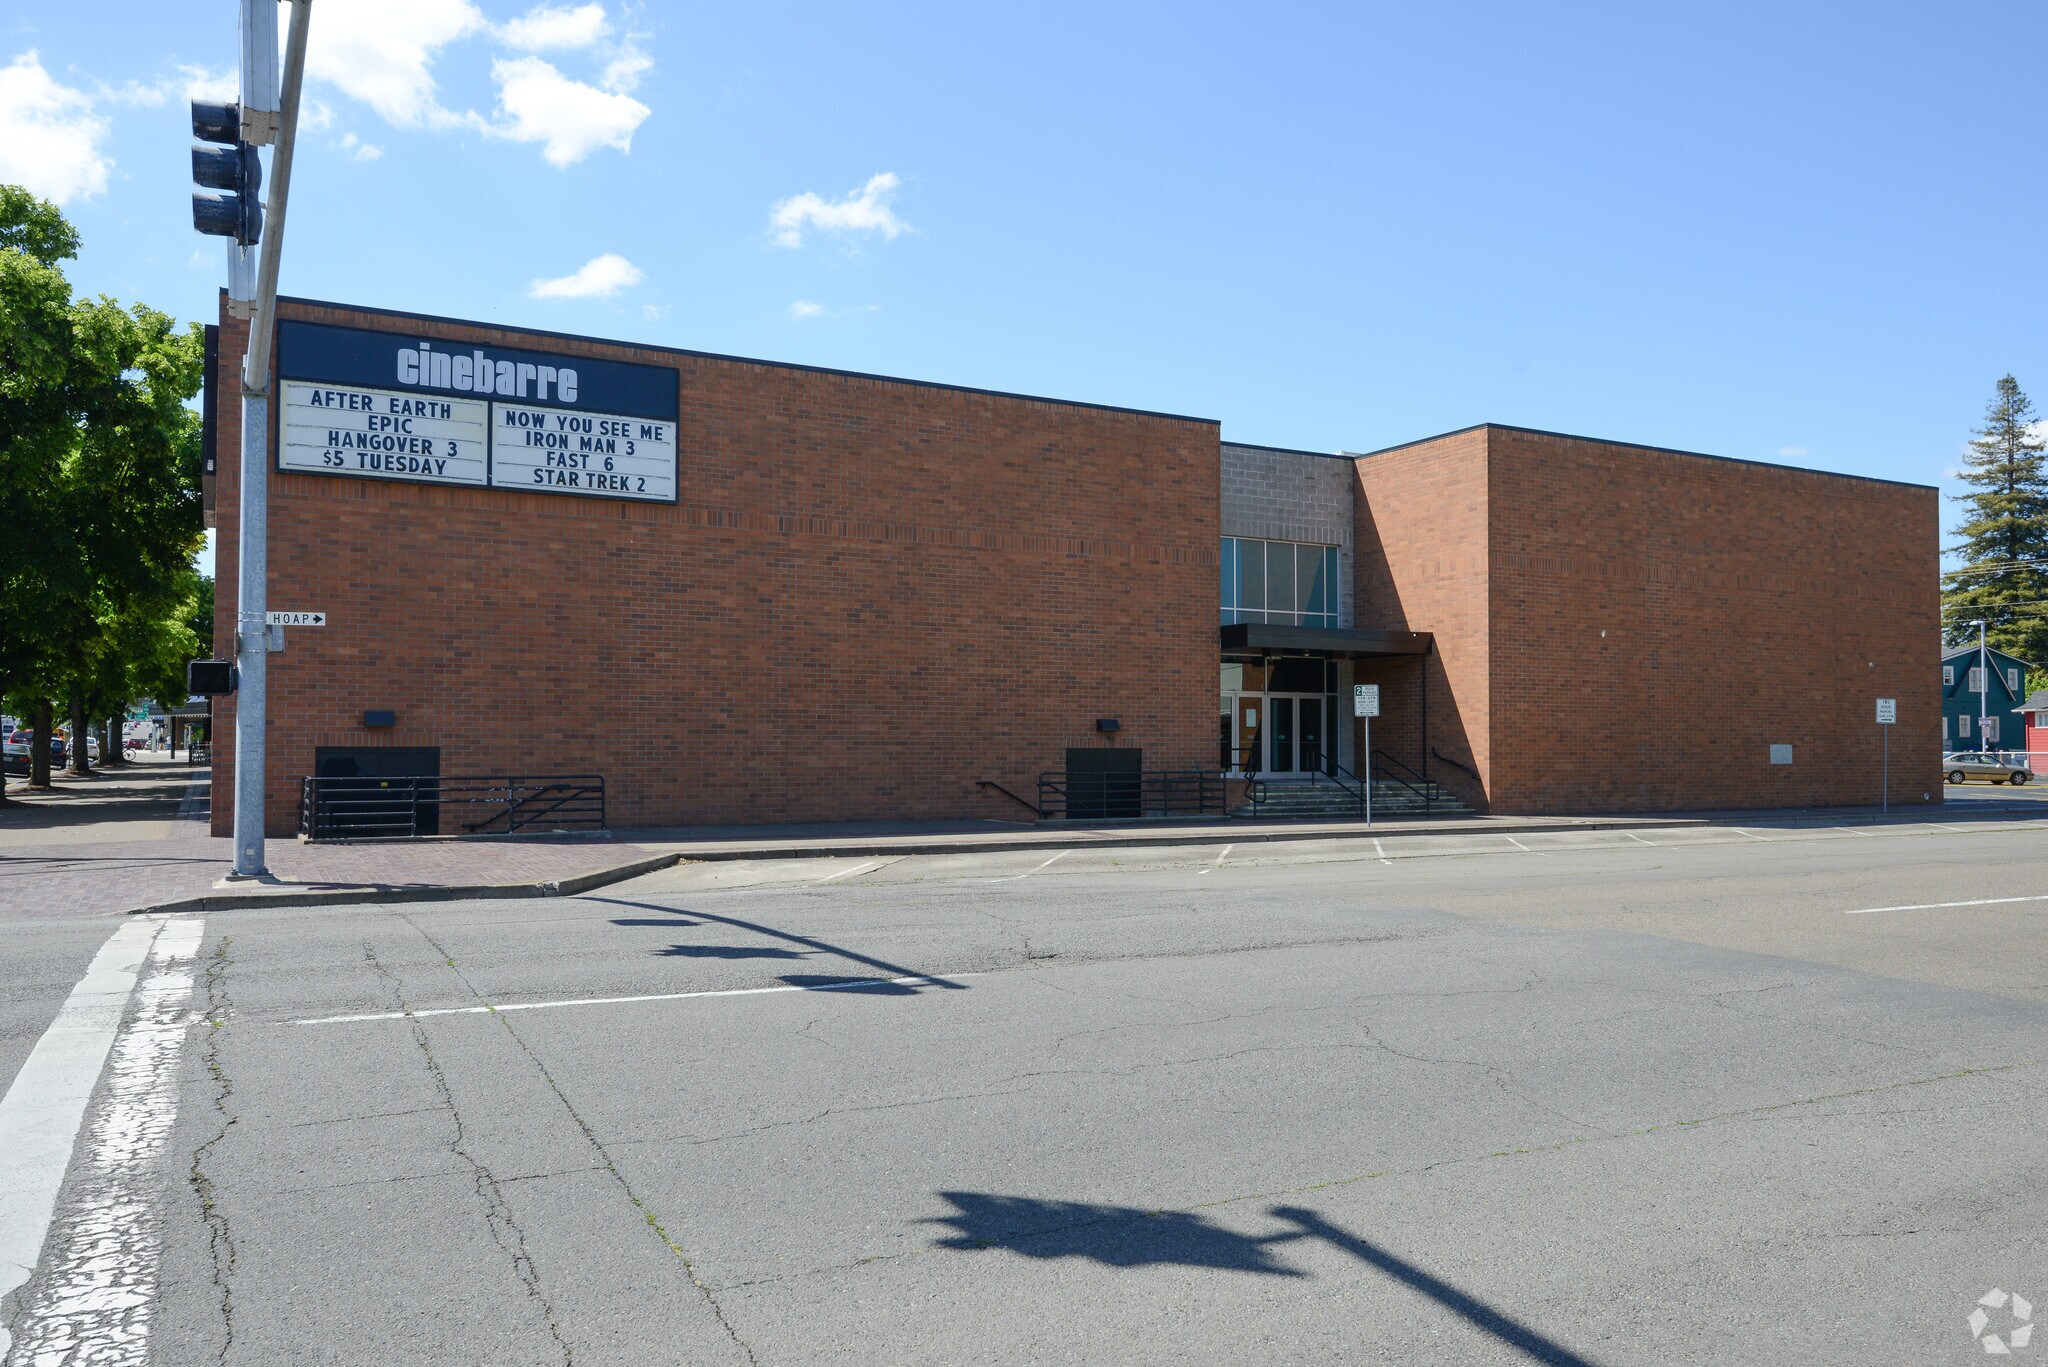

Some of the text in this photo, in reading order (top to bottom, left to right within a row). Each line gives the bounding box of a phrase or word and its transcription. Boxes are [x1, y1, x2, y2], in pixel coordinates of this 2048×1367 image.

[397, 342, 578, 402] cinebarre
[311, 389, 451, 419] AFTER EARTH
[368, 414, 413, 434] EPIC
[506, 410, 663, 441] NOW YOU SEE ME
[328, 430, 458, 457] HANGOVER 3
[526, 430, 635, 456] IRON MAN 3
[323, 449, 447, 475] $5 TUESDAY
[546, 450, 614, 472] FAST 6
[533, 467, 646, 493] STAR TREK 2
[273, 613, 309, 624] HOAP
